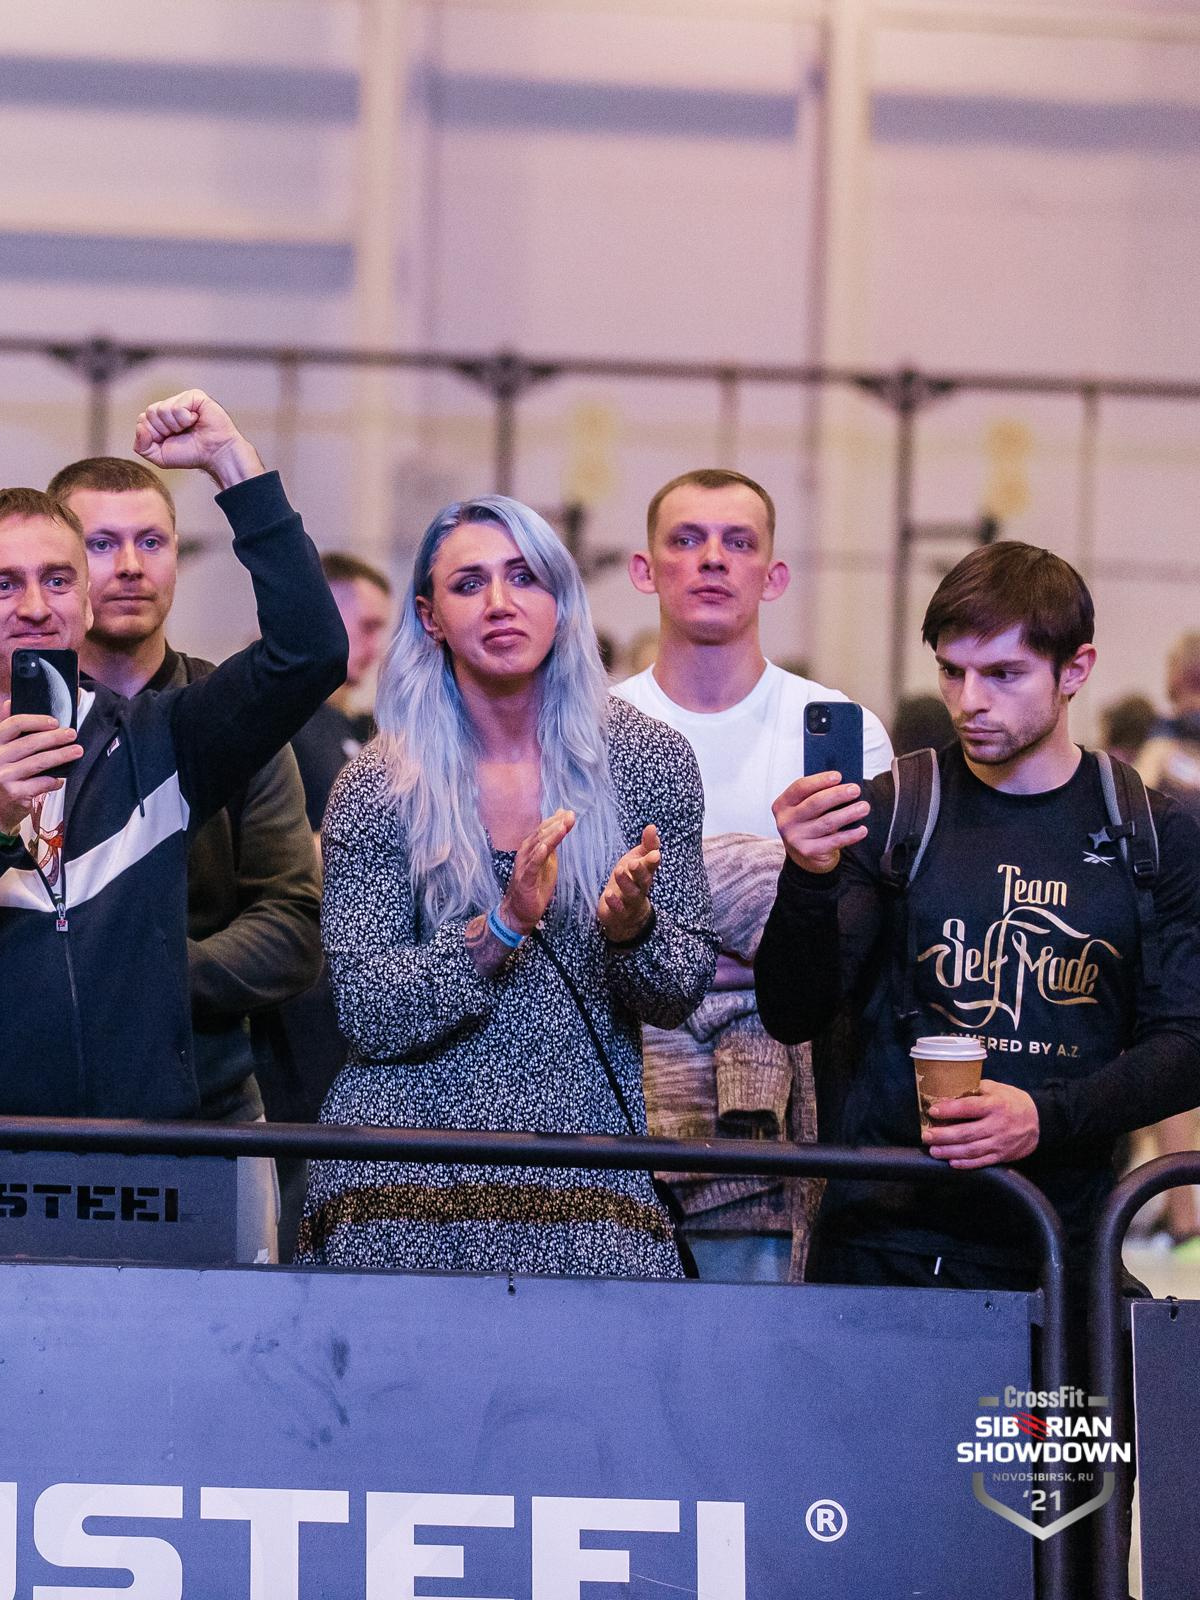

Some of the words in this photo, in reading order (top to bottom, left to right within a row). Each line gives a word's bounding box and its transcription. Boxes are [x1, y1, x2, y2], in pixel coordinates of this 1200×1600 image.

[997, 864, 1067, 915] Team
[918, 913, 1012, 1026] Self
[1009, 930, 1118, 1028] Made
[939, 1032, 1022, 1053] ERED
[1029, 1041, 1052, 1055] BY
